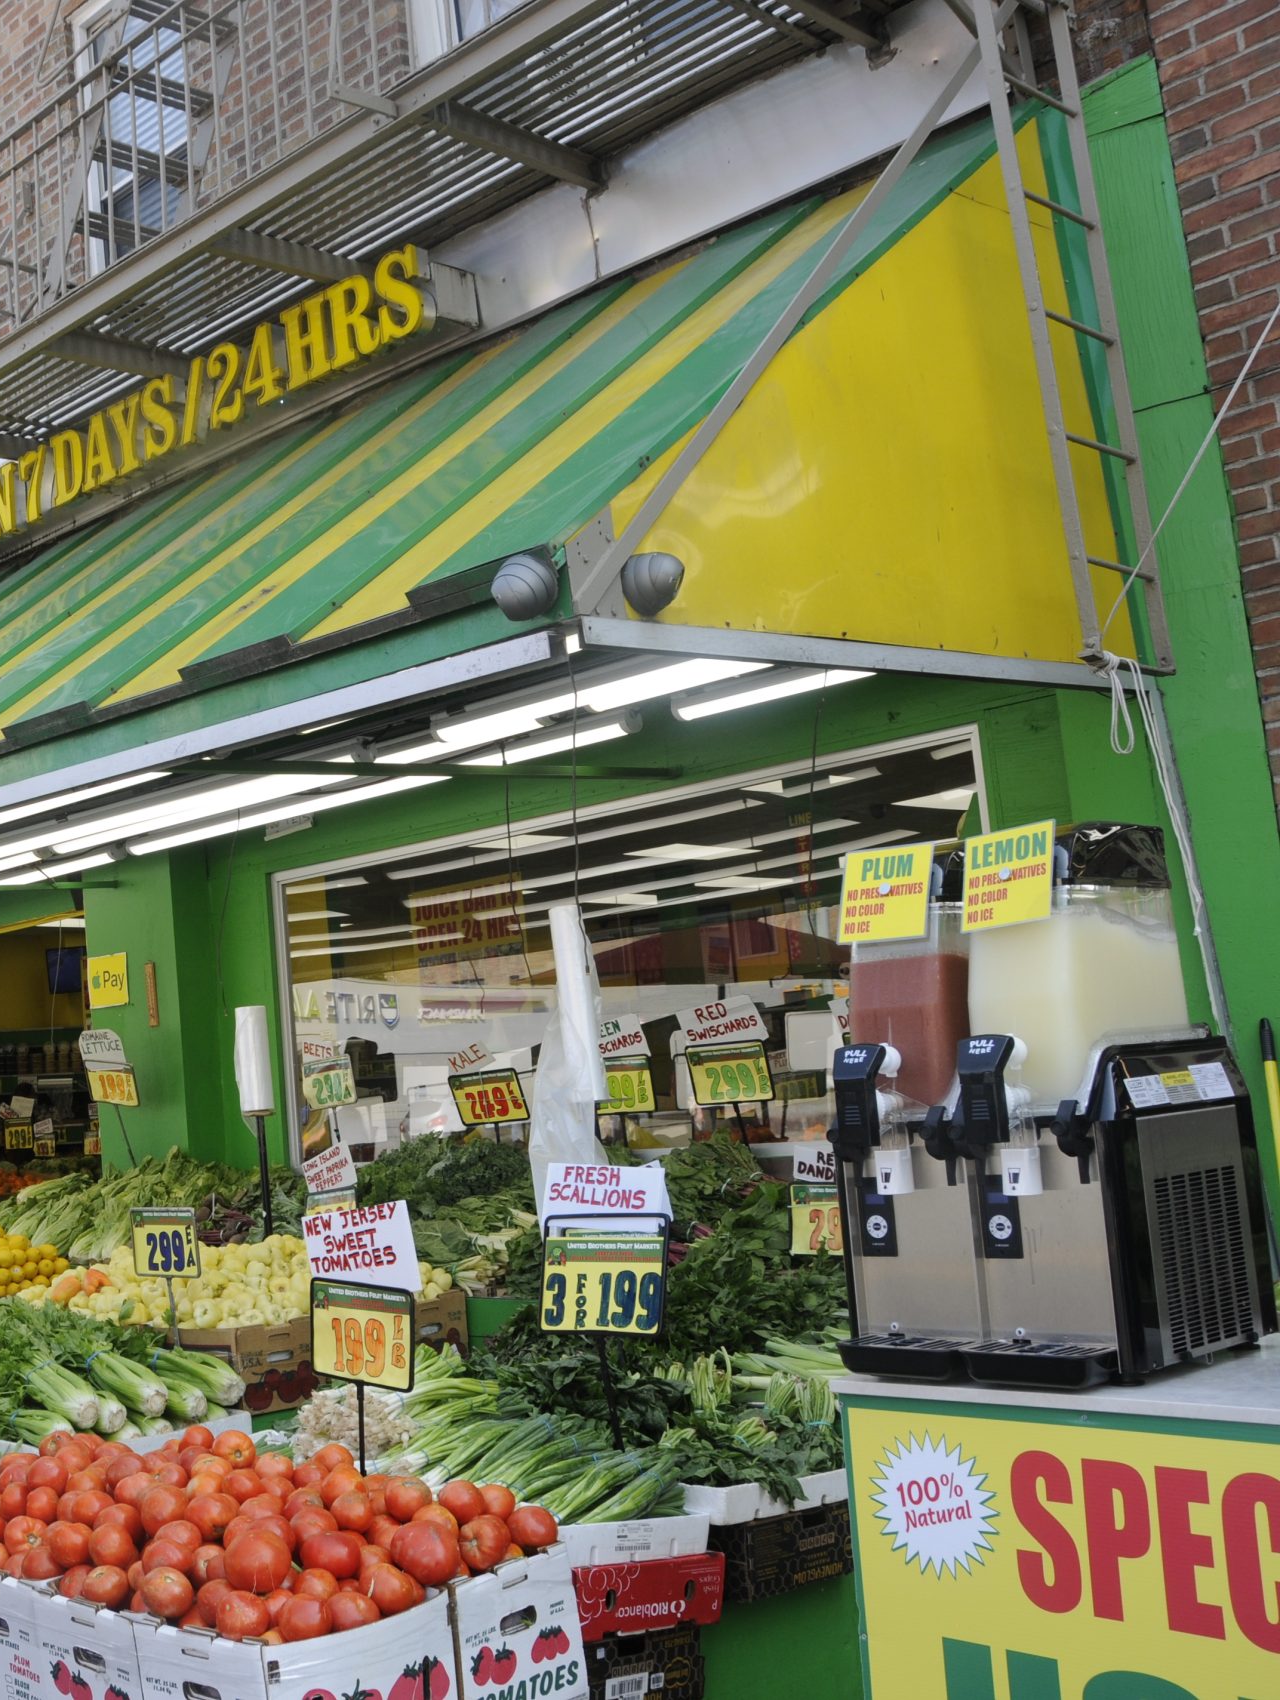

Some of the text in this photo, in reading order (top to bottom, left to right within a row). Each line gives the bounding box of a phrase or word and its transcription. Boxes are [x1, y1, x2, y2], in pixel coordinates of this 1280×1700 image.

[971, 830, 1048, 870] LEMON
[861, 853, 914, 882] PLUM
[847, 888, 858, 901] NO
[969, 877, 981, 890] NO
[968, 888, 1009, 906] NO COLOR
[845, 903, 885, 918] NO COLOR
[967, 908, 994, 924] NO ICE
[461, 918, 483, 944] 24
[844, 920, 871, 935] NO ICE
[103, 970, 125, 991] Pay
[694, 1002, 728, 1025] RED
[81, 1031, 110, 1043] ROMAINE
[686, 1015, 758, 1042] SWISCHARDS
[82, 1039, 122, 1055] LETTUCE
[303, 1041, 333, 1058] BEETS
[844, 1049, 868, 1058] PULL
[969, 1039, 996, 1048] PULL
[447, 1043, 487, 1073] KALE
[98, 1073, 125, 1101] 199
[705, 1062, 757, 1100] 299
[303, 1145, 342, 1174] LONG ISLAND
[306, 1156, 350, 1186] SWEET PAPRIKA
[315, 1173, 343, 1193] PEPPERS
[563, 1165, 621, 1188] FRESH
[549, 1182, 647, 1211] SCALLIONS
[304, 1201, 397, 1238] NEW JERSEY
[146, 1223, 197, 1273] 299 EA
[323, 1227, 377, 1254] SWEET
[567, 1242, 587, 1250] UNITED
[588, 1242, 616, 1250] BROTHERS
[617, 1242, 634, 1250] FRUIT
[310, 1245, 398, 1274] TOMATOES
[328, 1286, 407, 1302] UNITED BROTHERS FRUIT MARKETS
[544, 1269, 663, 1331] 3 FOR 199
[330, 1315, 407, 1378] 199 LB
[895, 1472, 965, 1509] 100%
[904, 1499, 974, 1534] Natural
[1010, 1449, 1280, 1656] SPEC
[793, 1561, 844, 1585] HONEYGLOW
[619, 1601, 669, 1619] RIOblanco
[4, 1638, 21, 1651] STAKES
[13, 1653, 31, 1670] PLUM
[8, 1662, 41, 1685] TOMATOES
[477, 1660, 580, 1700] MATOES
[15, 1688, 30, 1700] MORE
